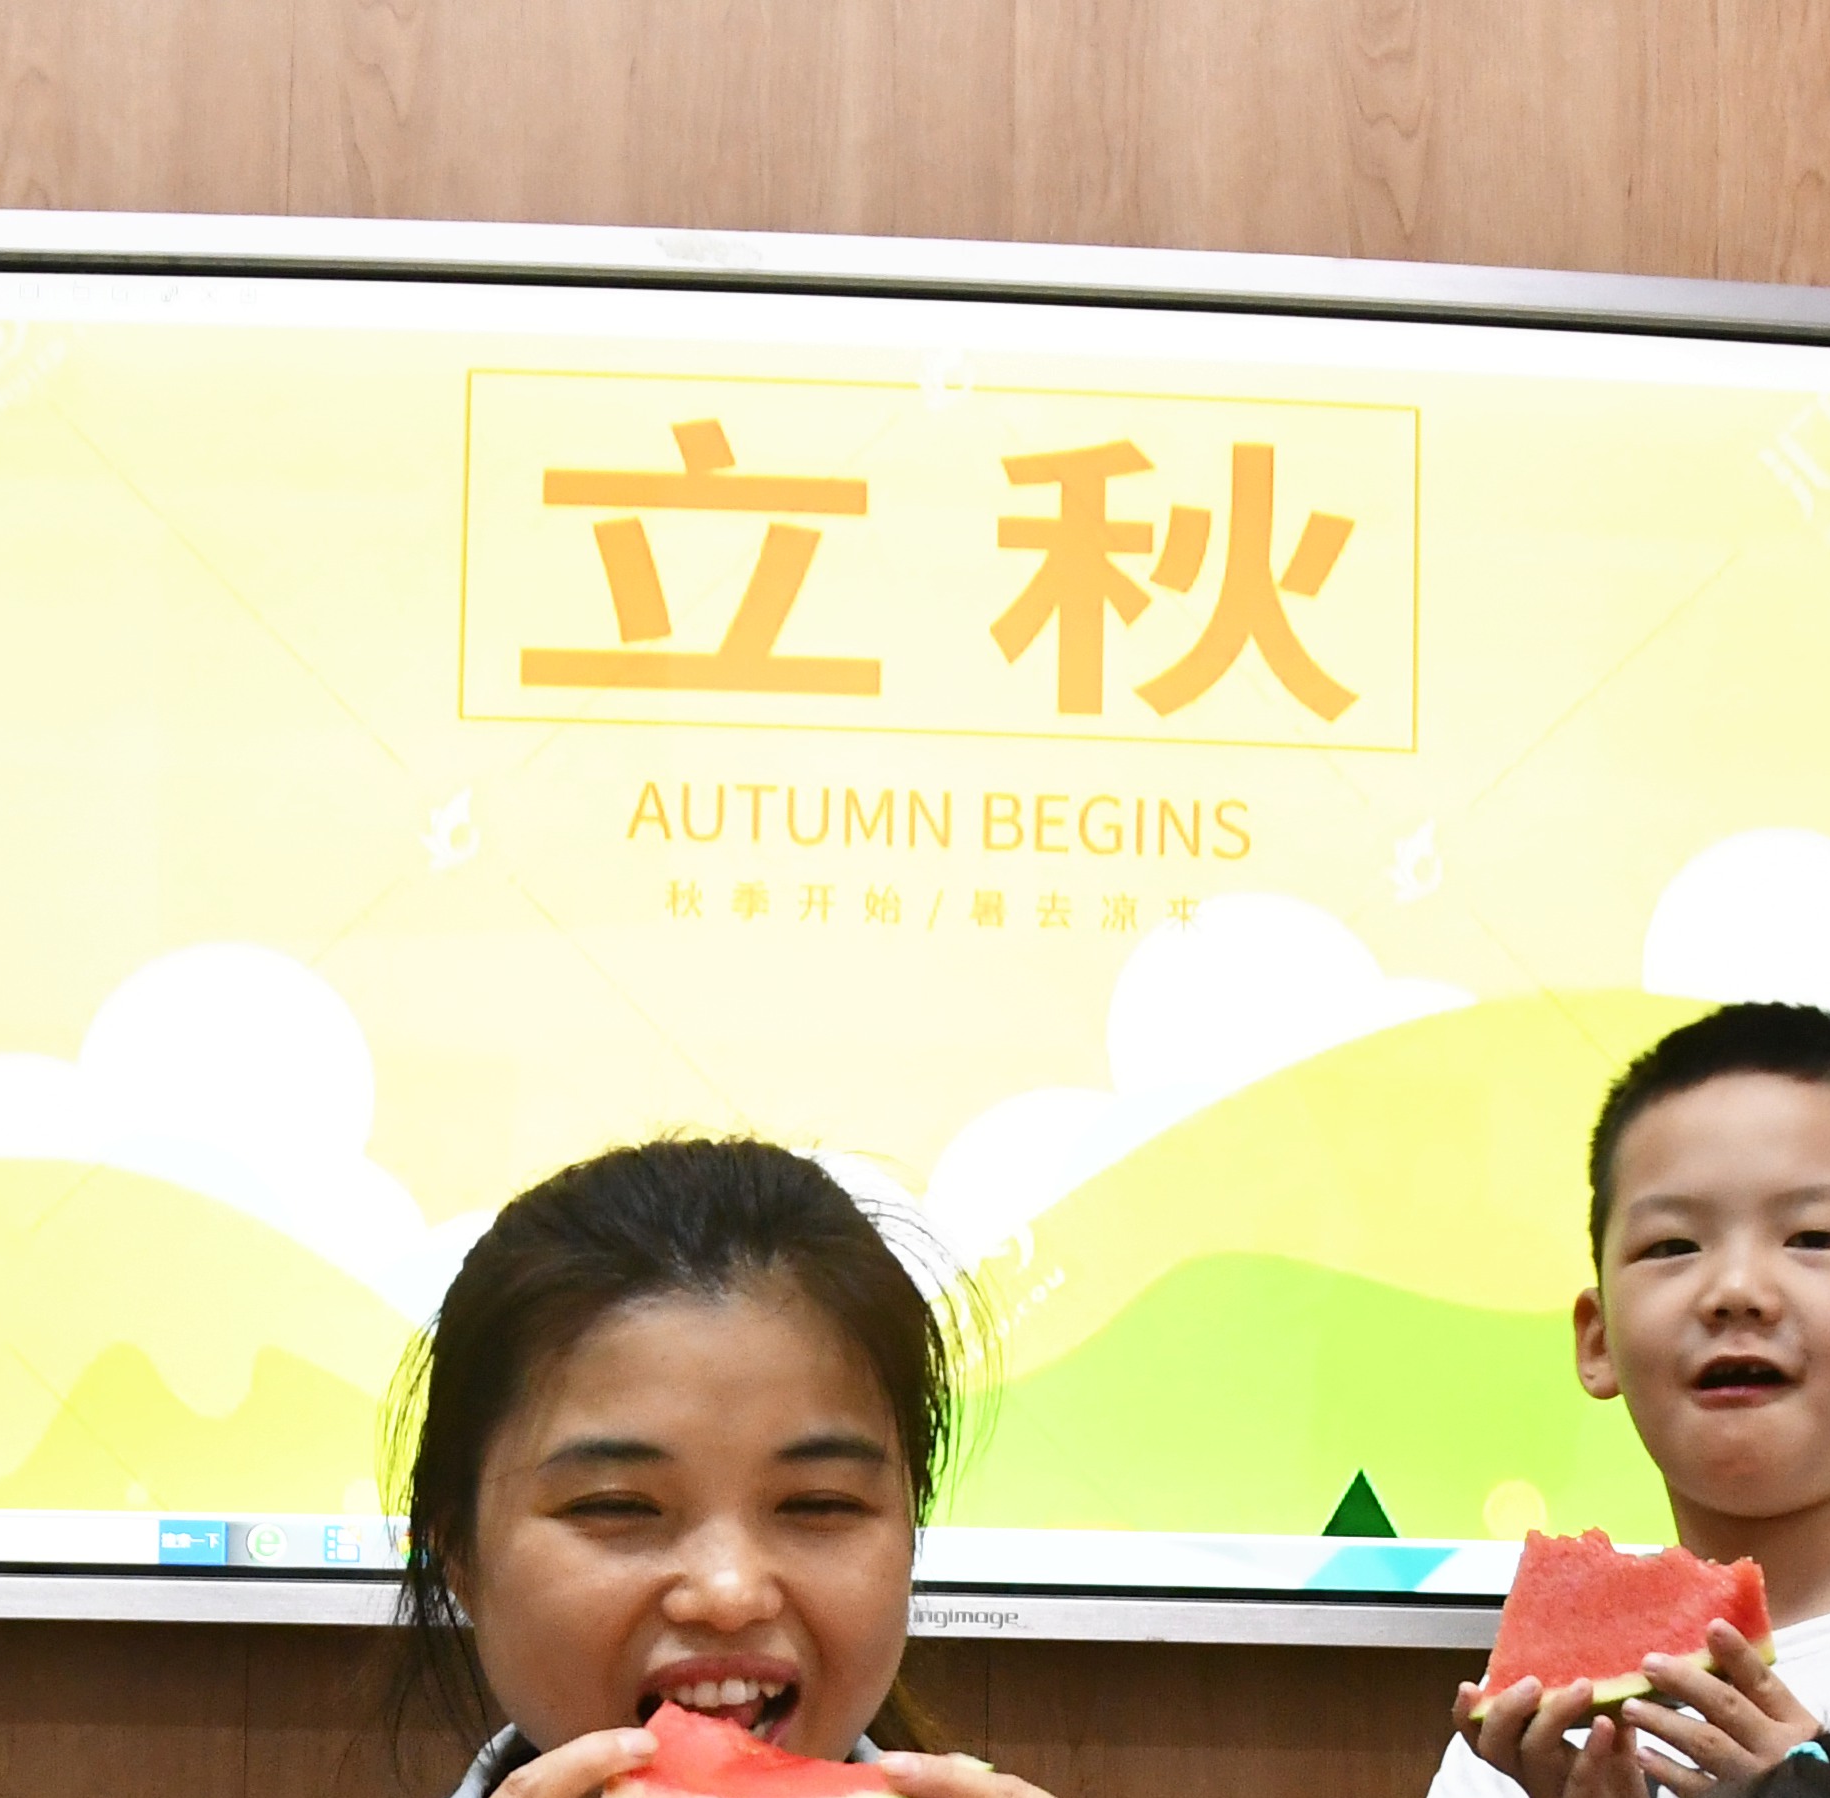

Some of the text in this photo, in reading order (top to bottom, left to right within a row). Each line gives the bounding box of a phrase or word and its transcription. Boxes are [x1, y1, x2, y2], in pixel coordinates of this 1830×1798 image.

[519, 418, 1360, 724] 立秋
[625, 780, 1252, 862] AUTUMN BEGINS
